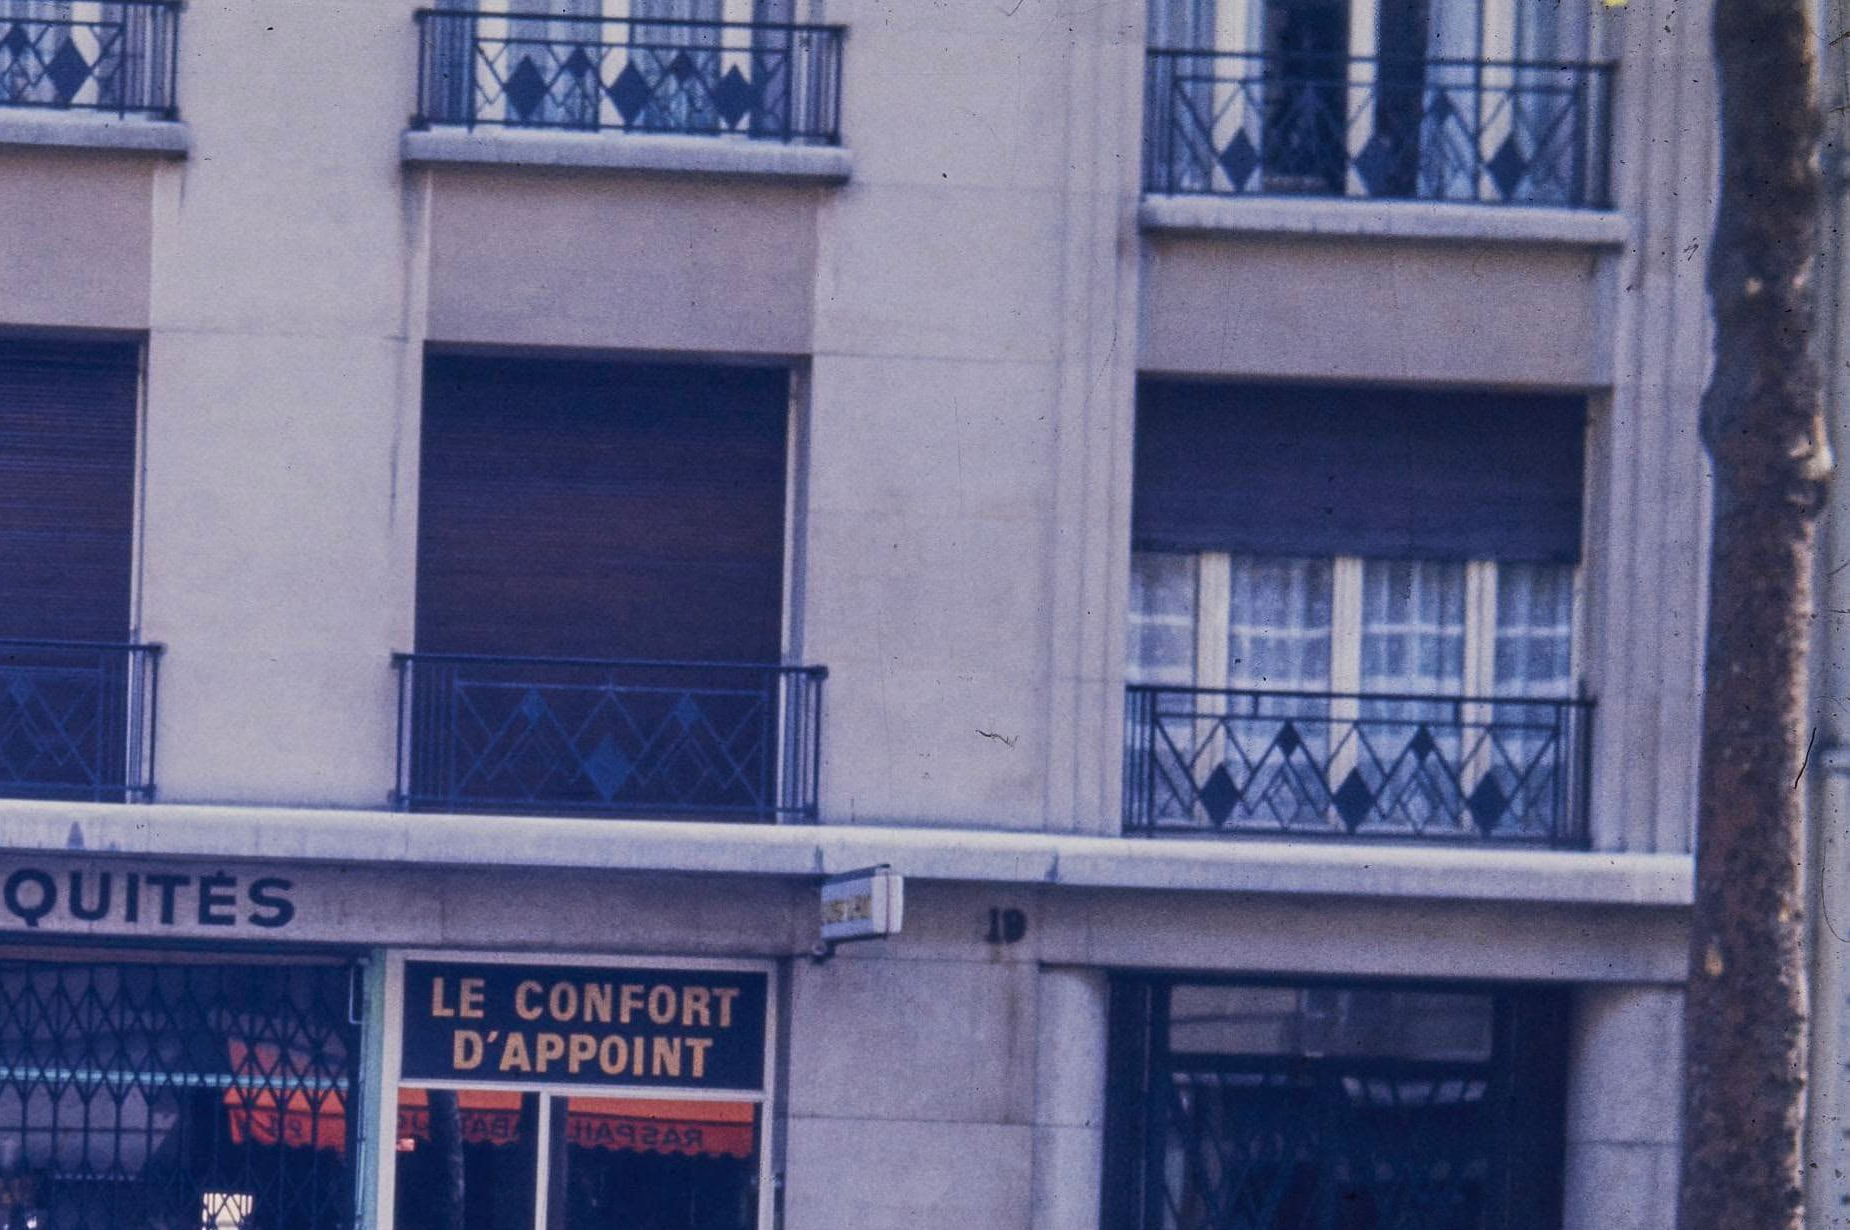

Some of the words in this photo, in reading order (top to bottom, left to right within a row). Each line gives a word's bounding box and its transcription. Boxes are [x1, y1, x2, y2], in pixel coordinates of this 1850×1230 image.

[431, 976, 486, 1019] LE
[515, 979, 740, 1028] CONFORT
[453, 1029, 713, 1078] D'APPOINT
